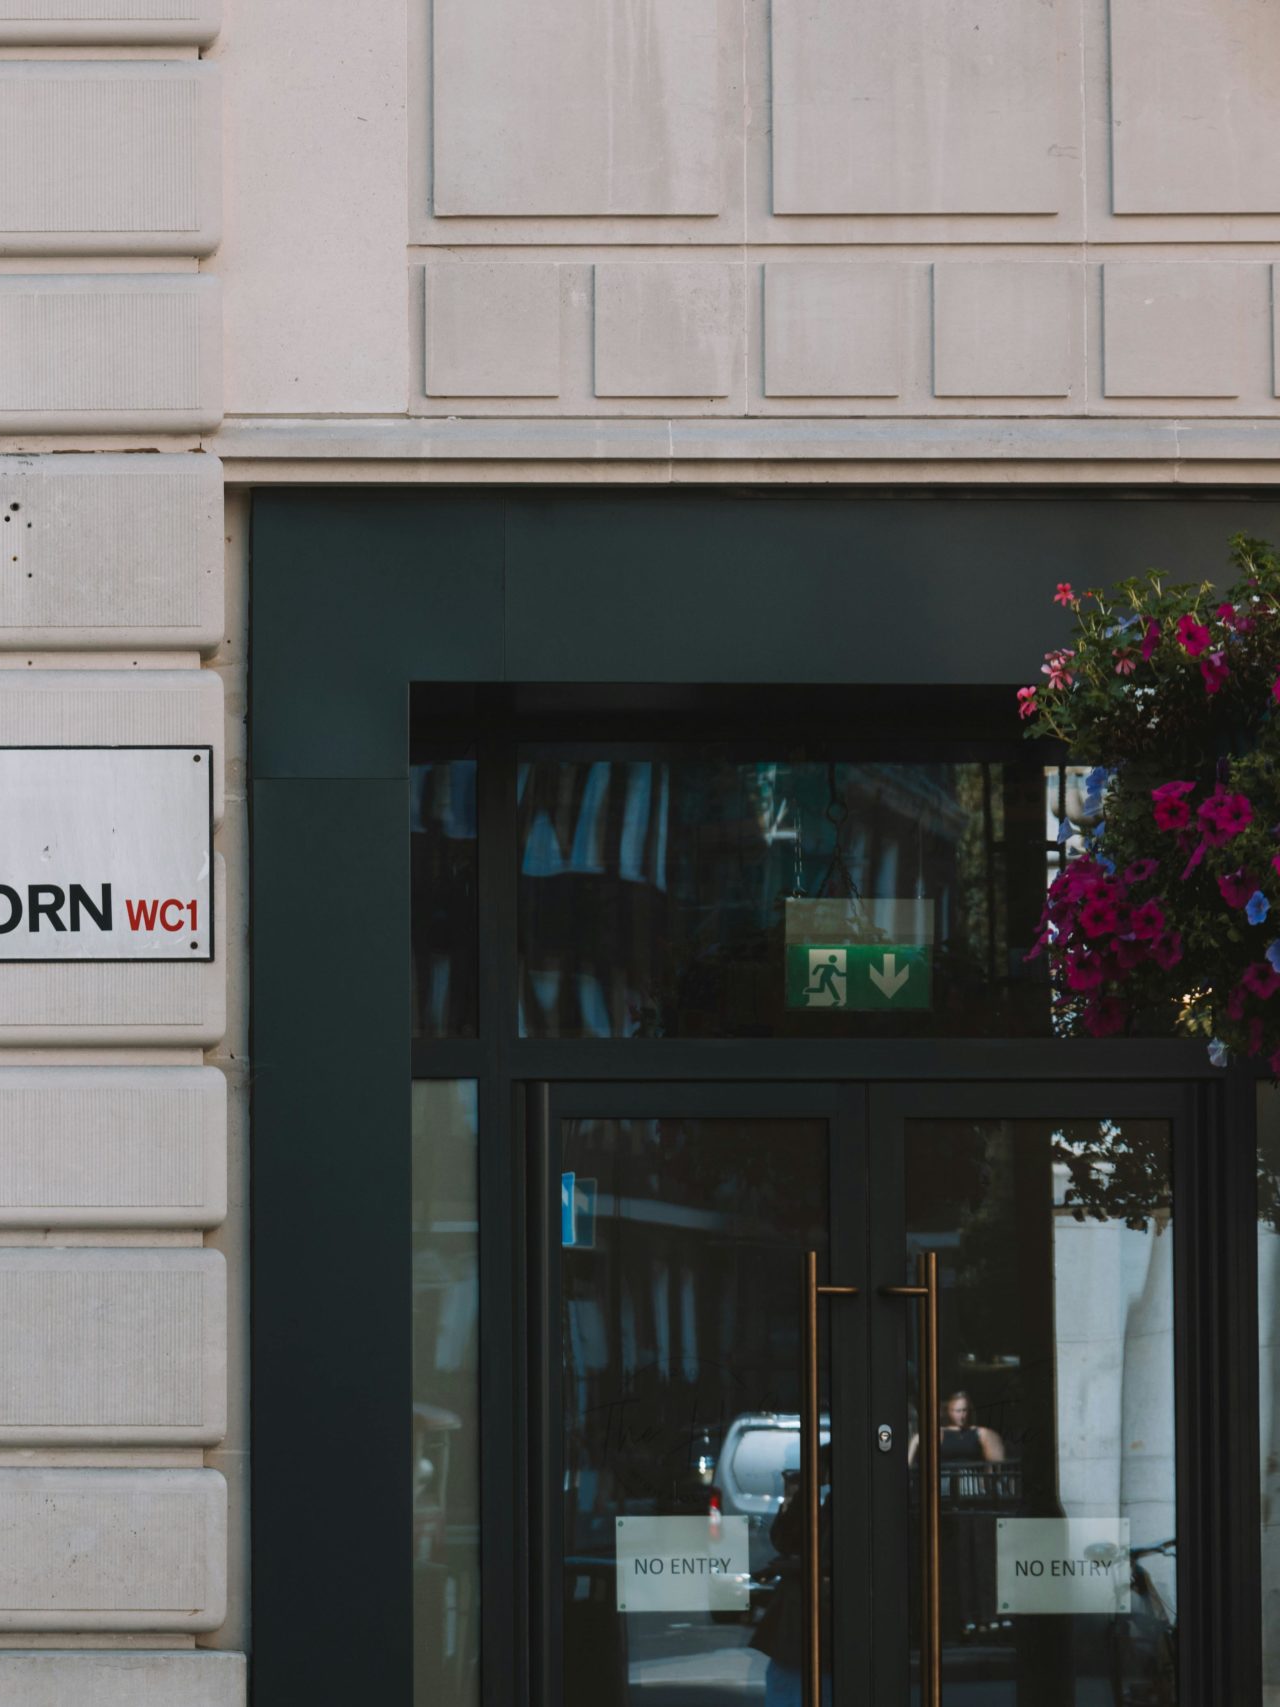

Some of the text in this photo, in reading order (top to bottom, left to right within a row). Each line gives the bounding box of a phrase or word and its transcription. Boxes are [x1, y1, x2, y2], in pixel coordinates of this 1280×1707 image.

[125, 899, 198, 932] WC1
[634, 1558, 731, 1575] NO ENTRY
[1015, 1560, 1112, 1576] NO ENTRY
